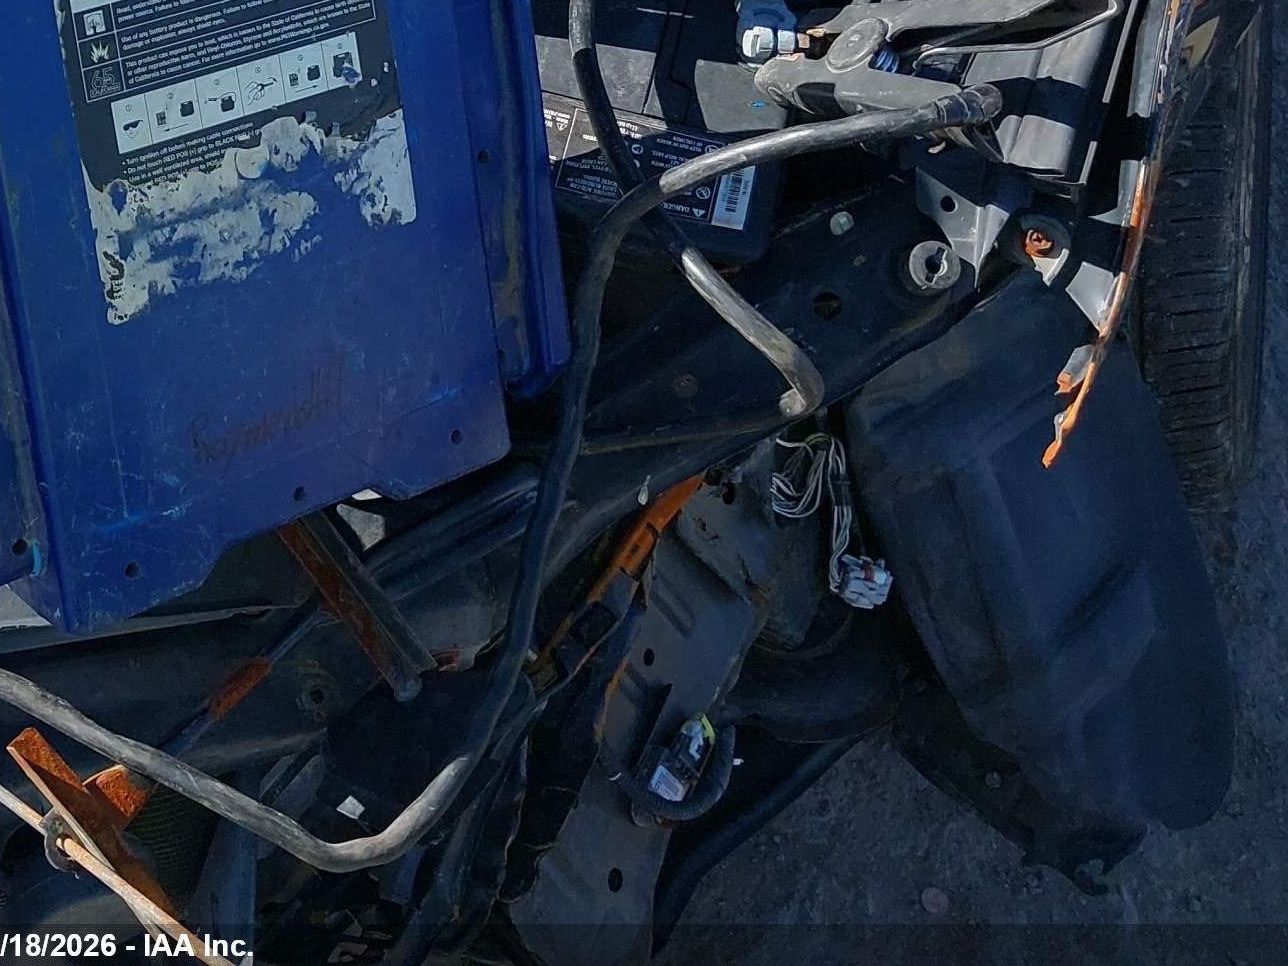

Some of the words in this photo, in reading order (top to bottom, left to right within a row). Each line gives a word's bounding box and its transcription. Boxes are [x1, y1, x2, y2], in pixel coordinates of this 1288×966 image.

[290, 9, 314, 22] California
[134, 70, 159, 83] California
[224, 43, 253, 57] information
[147, 56, 180, 71] reproductive
[89, 65, 116, 90] 65
[126, 156, 138, 166] Turn
[138, 149, 159, 162] ignition
[159, 147, 167, 156] off
[168, 141, 185, 153] before
[185, 135, 205, 147] making
[206, 130, 220, 141] cable
[127, 165, 136, 174] Do
[136, 162, 146, 172] not
[146, 157, 162, 168] touch
[162, 153, 175, 163] RED
[175, 149, 188, 159] POS
[196, 143, 207, 153] grip
[208, 141, 214, 149] to
[214, 135, 233, 147] BLACK
[128, 173, 140, 183] Use
[151, 166, 163, 176] well
[163, 158, 189, 172] ventilated
